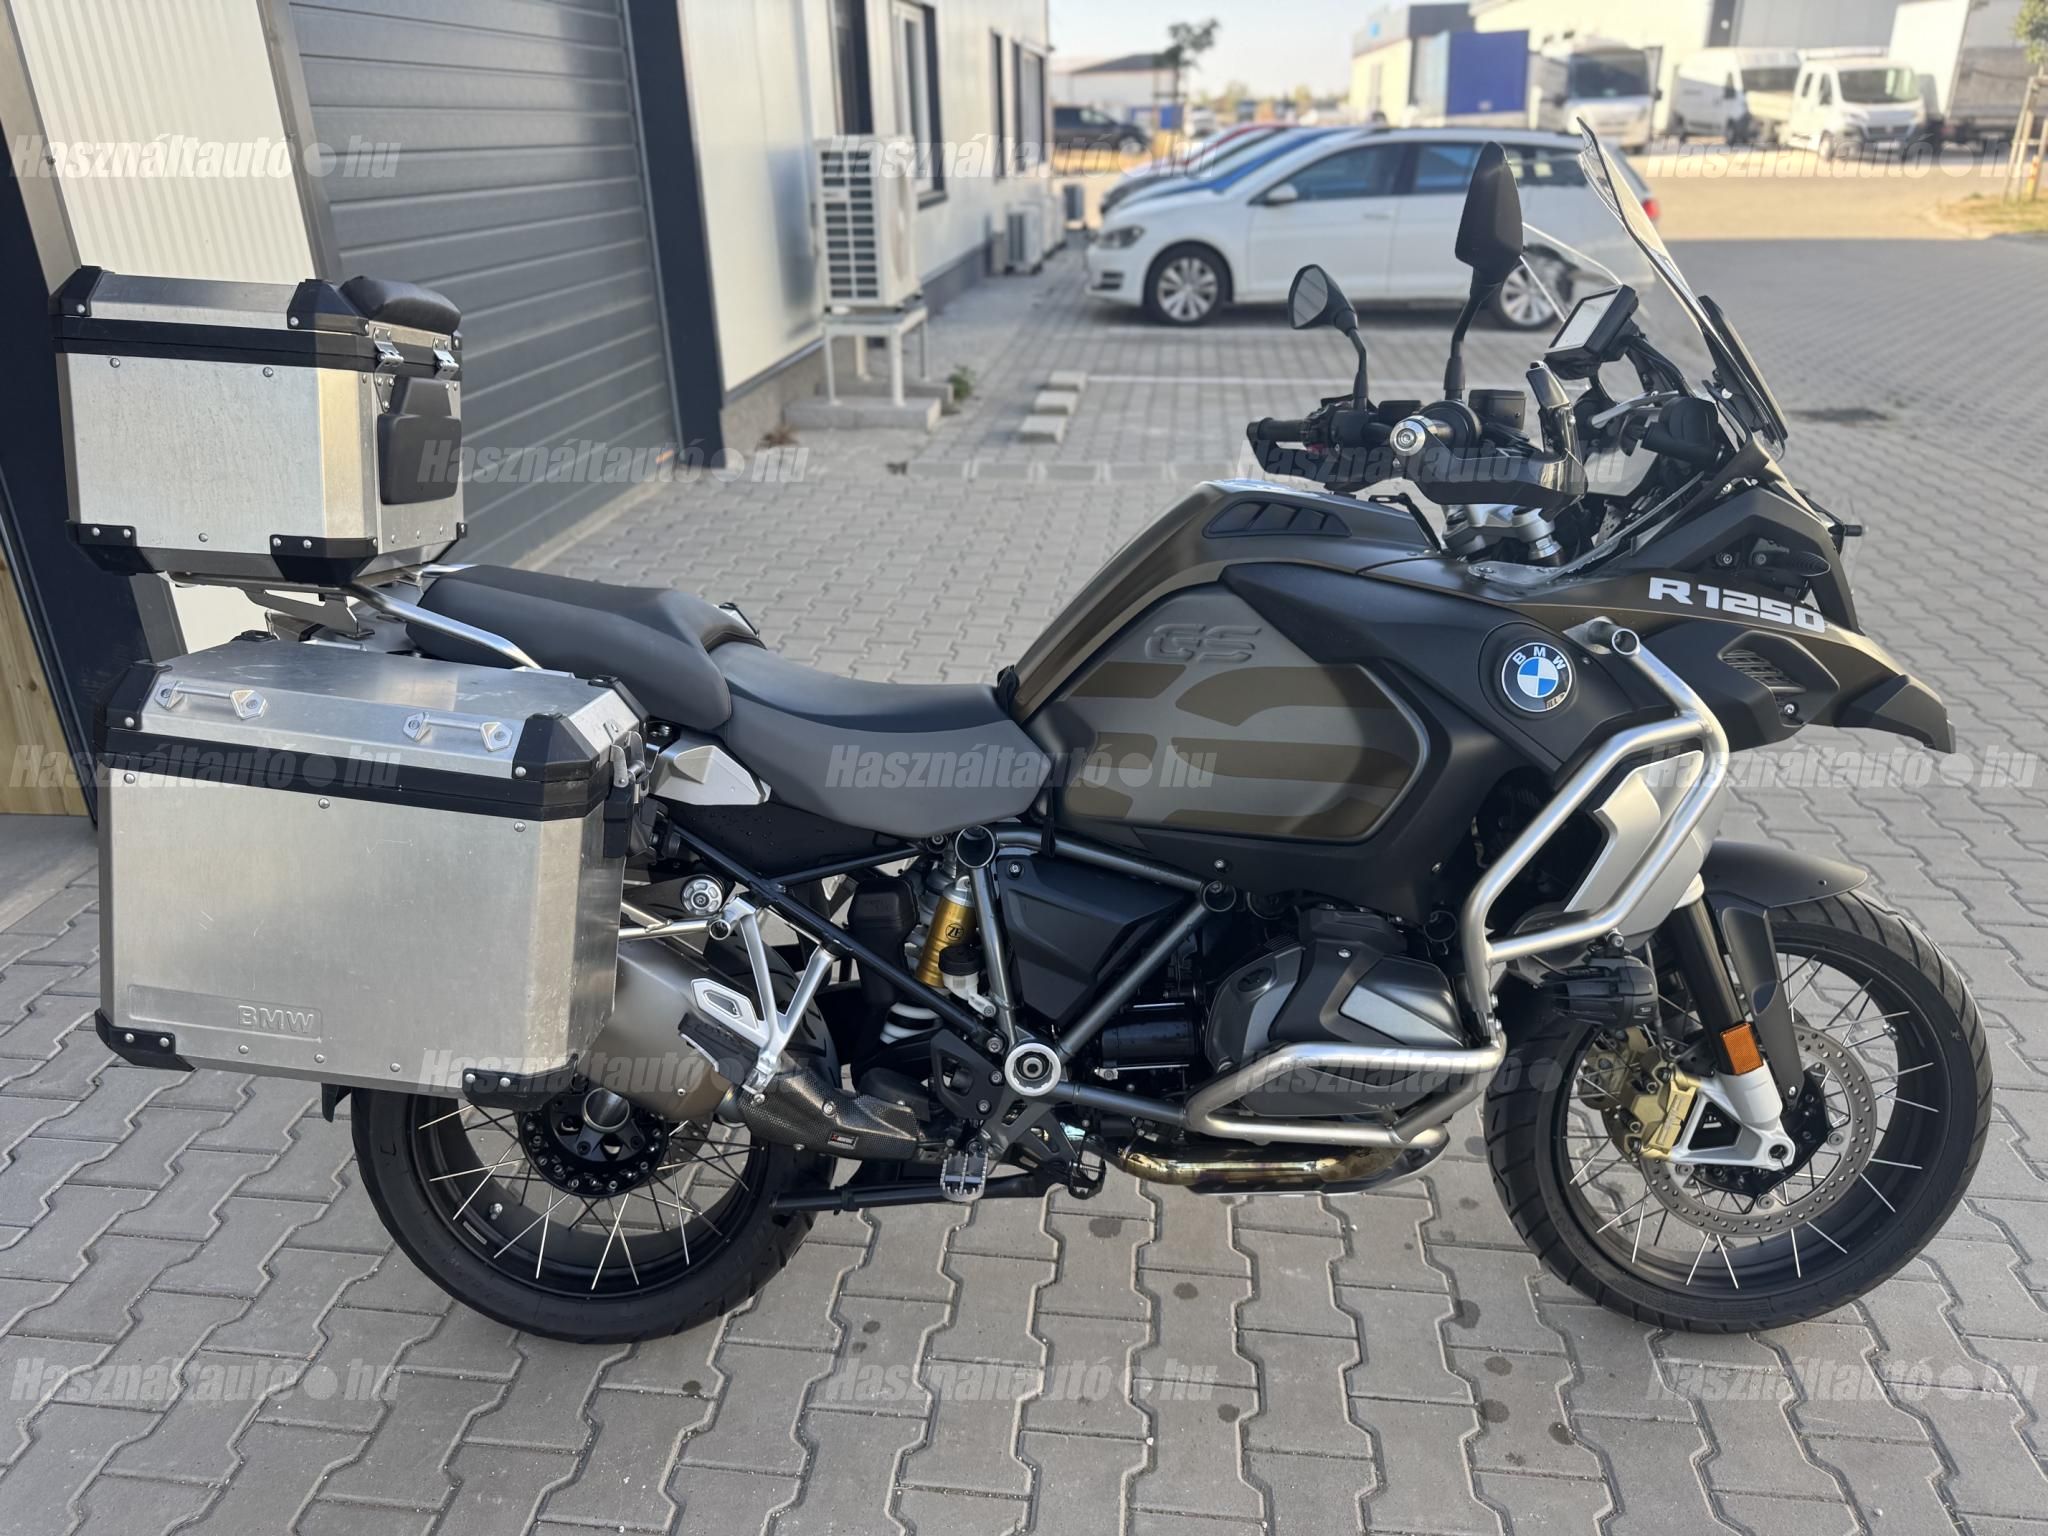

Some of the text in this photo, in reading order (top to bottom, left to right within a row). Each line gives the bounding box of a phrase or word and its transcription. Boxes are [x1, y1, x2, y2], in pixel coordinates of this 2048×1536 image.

[1648, 577, 1826, 634] R 1250
[1144, 623, 1262, 663] GS
[1512, 646, 1567, 670] BMW
[238, 1004, 314, 1034] BMW
